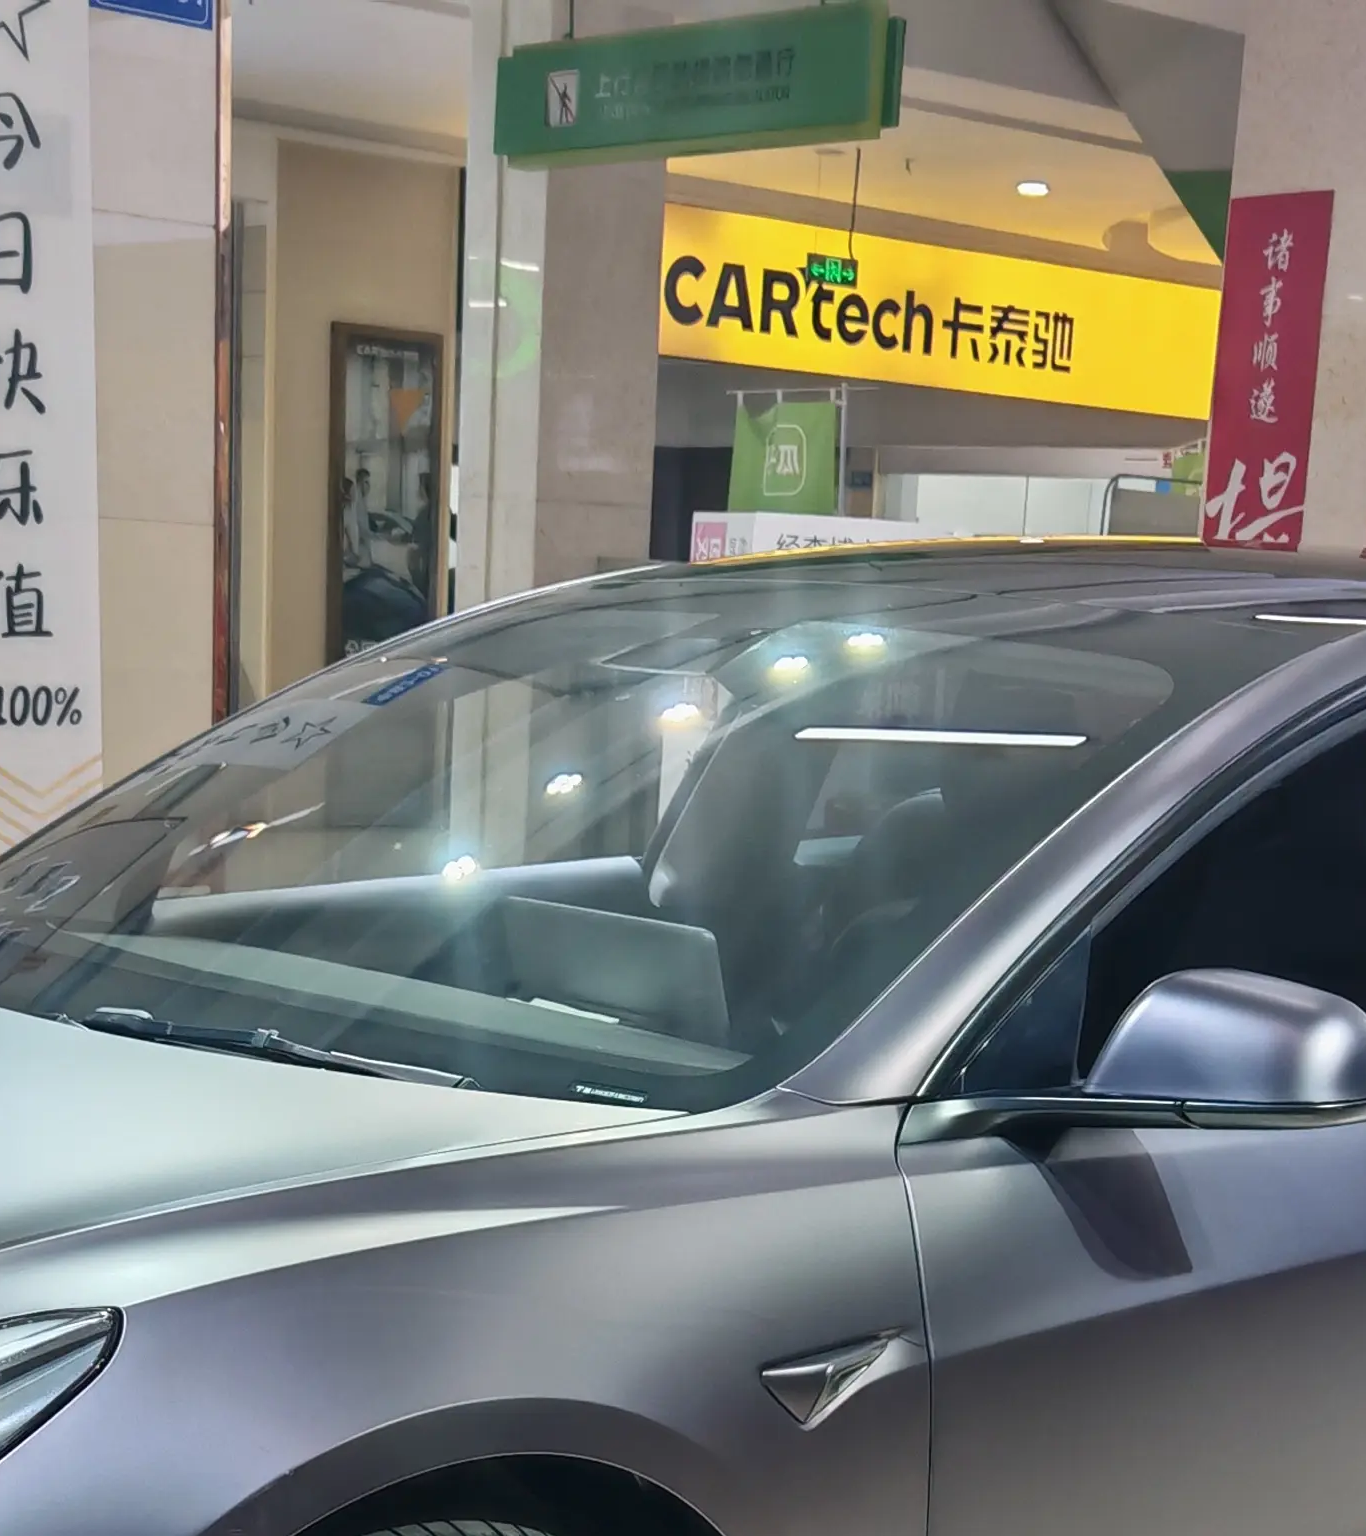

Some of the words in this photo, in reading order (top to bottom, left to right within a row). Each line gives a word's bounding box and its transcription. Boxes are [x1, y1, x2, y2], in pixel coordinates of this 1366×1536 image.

[664, 254, 934, 357] CARtech
[941, 296, 1075, 374] 卡泰驰
[1247, 227, 1295, 424] 诸事顺遂
